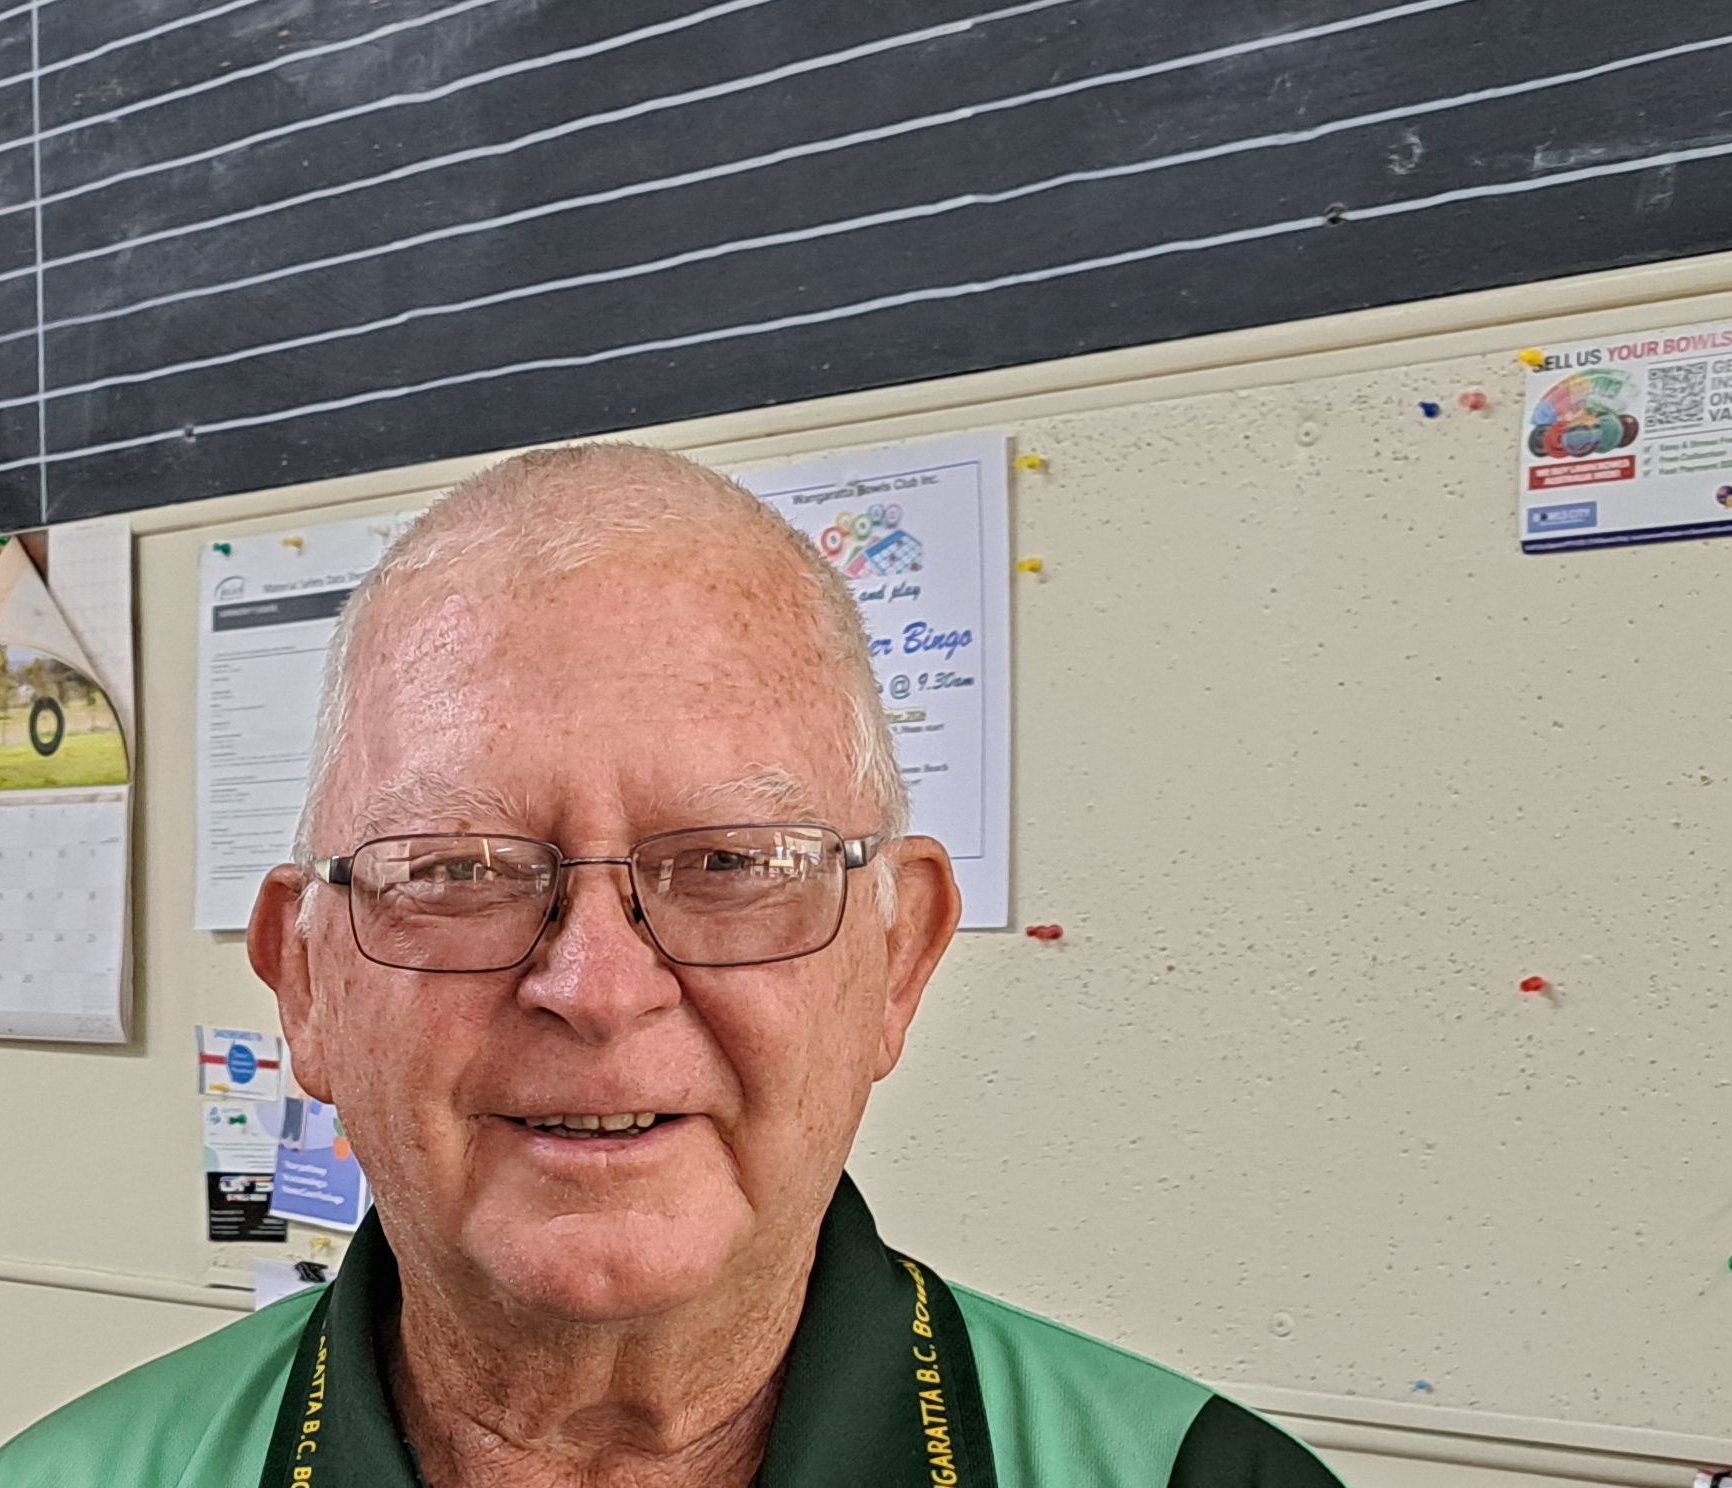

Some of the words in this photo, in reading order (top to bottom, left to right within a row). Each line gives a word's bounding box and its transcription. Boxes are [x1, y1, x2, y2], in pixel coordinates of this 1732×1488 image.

[1576, 349, 1603, 366] US
[1607, 340, 1659, 362] YOUR
[1662, 330, 1732, 355] BOWLS
[903, 620, 973, 660] Bingo
[889, 674, 911, 700] @
[305, 1330, 328, 1417] RATTA
